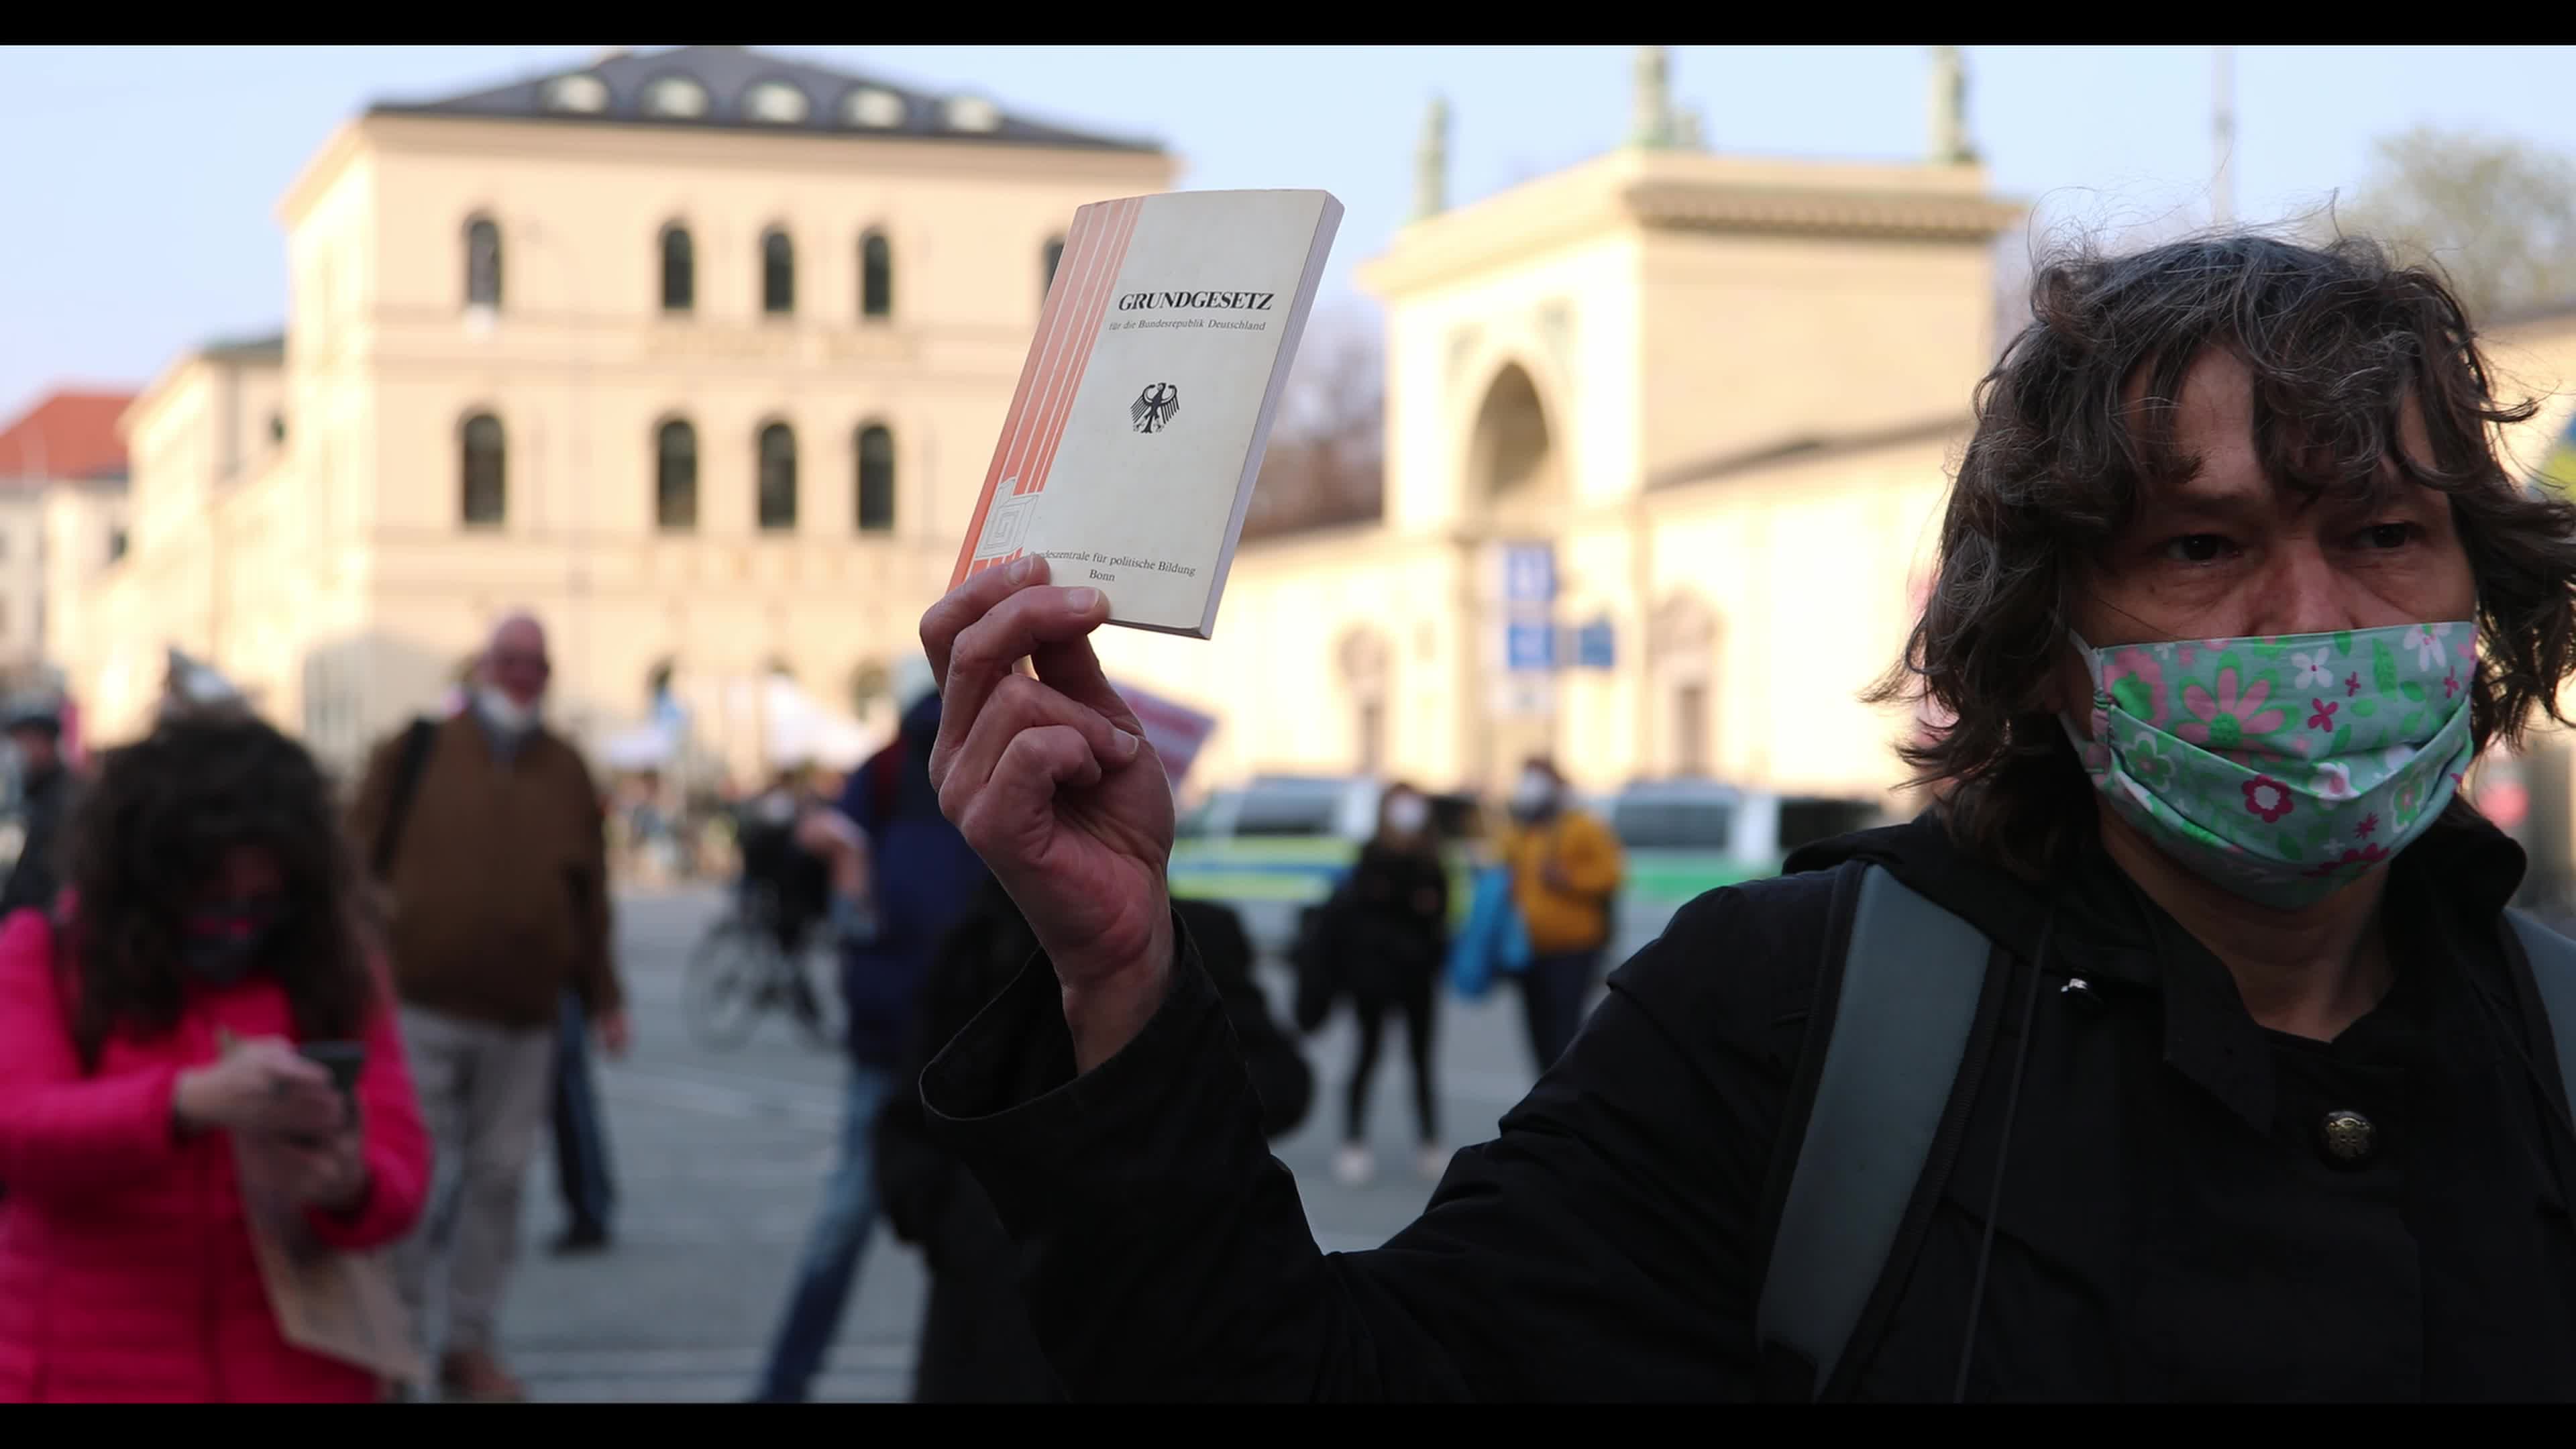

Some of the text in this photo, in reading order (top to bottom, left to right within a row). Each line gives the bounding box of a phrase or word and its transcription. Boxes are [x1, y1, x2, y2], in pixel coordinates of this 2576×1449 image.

[1118, 291, 1274, 311] GRUNDGESETZ
[1109, 319, 1266, 331] für die Bundesrepublik Deutschland
[1092, 553, 1108, 563] für
[1110, 556, 1156, 569] politische
[1159, 561, 1196, 577] Bildung
[1089, 569, 1115, 582] Bonn
